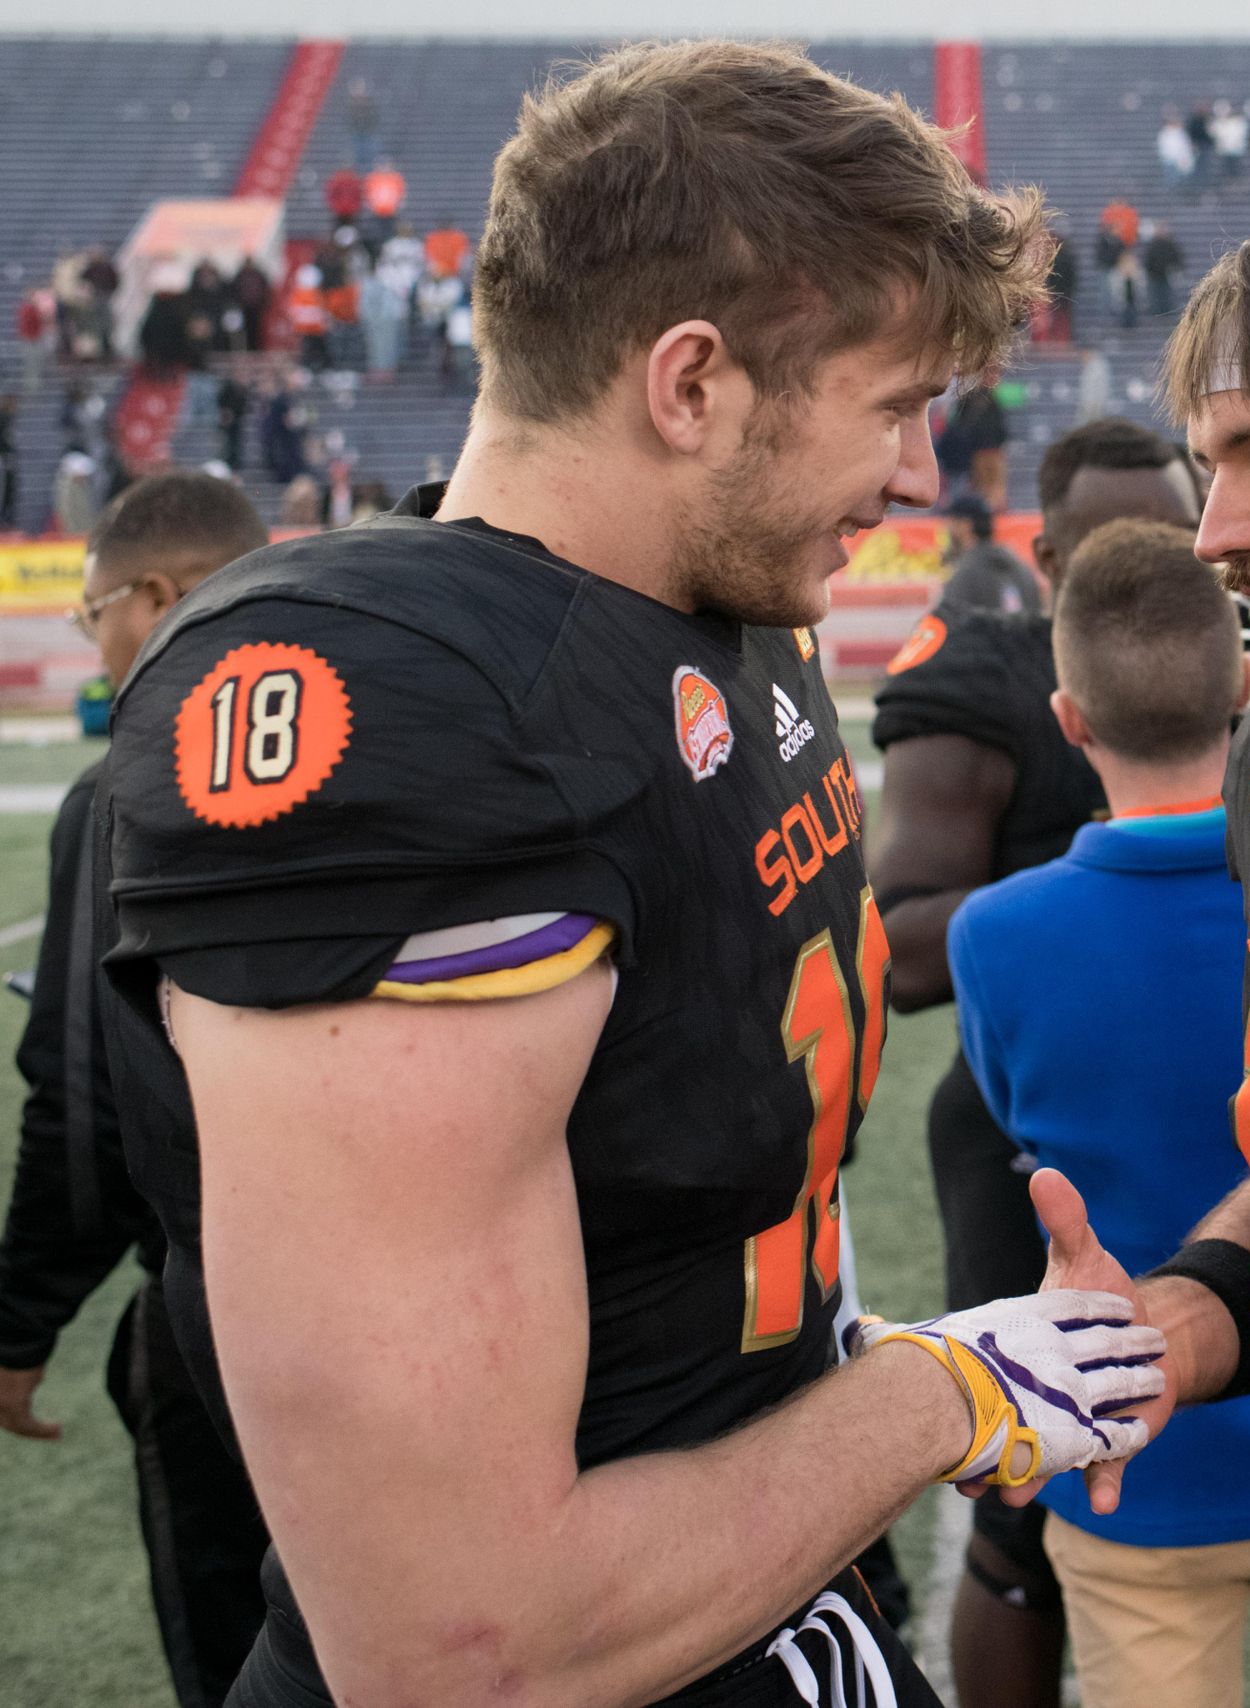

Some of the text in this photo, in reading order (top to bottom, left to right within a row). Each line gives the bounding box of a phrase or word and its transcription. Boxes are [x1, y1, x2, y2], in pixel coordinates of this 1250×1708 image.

[208, 669, 305, 795] 18
[779, 718, 816, 763] adidas
[754, 747, 862, 917] SOUTH
